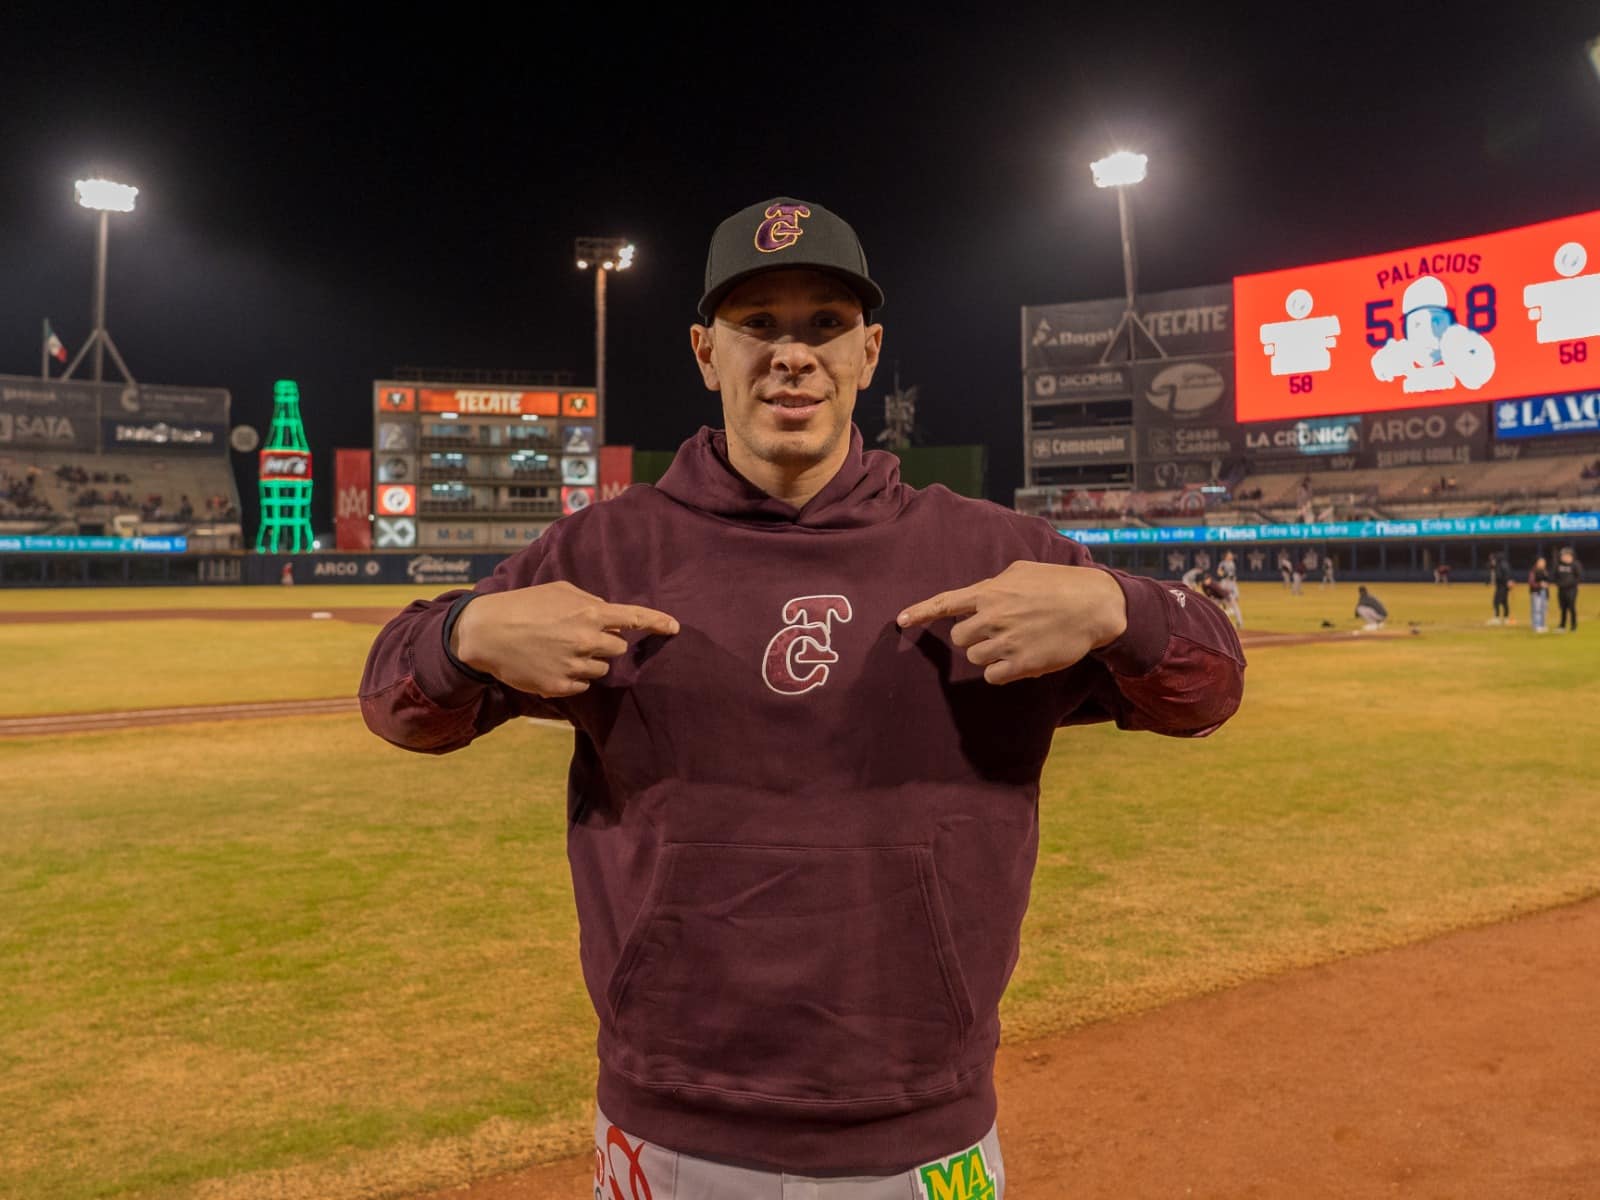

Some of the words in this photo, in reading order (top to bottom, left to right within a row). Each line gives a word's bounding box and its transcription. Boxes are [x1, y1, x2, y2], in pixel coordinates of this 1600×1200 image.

[1377, 254, 1482, 290] PALACIOS
[1143, 304, 1230, 337] TECATE
[1559, 340, 1587, 364] 58
[1289, 373, 1313, 394] 58
[454, 390, 524, 415] TECATE
[1522, 397, 1561, 427] LA
[1246, 431, 1270, 448] LA
[1369, 415, 1446, 443] ARCO
[314, 561, 358, 576] ARCO
